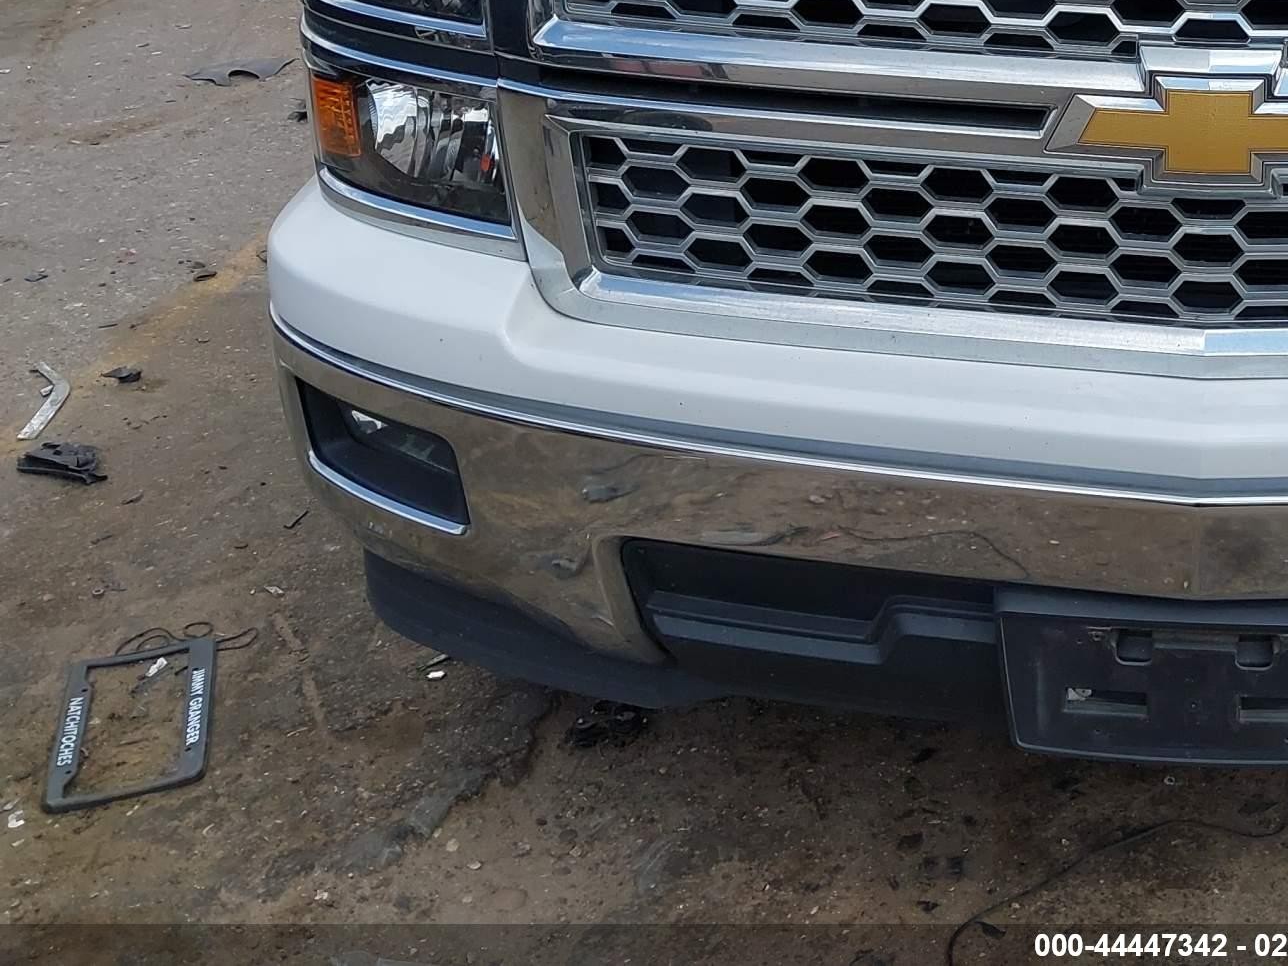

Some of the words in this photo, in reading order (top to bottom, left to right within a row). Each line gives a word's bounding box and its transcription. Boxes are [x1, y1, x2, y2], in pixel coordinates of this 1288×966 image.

[190, 668, 206, 697] JIMMY
[56, 697, 84, 767] NATCHITOCHES
[185, 697, 203, 746] GRANGER
